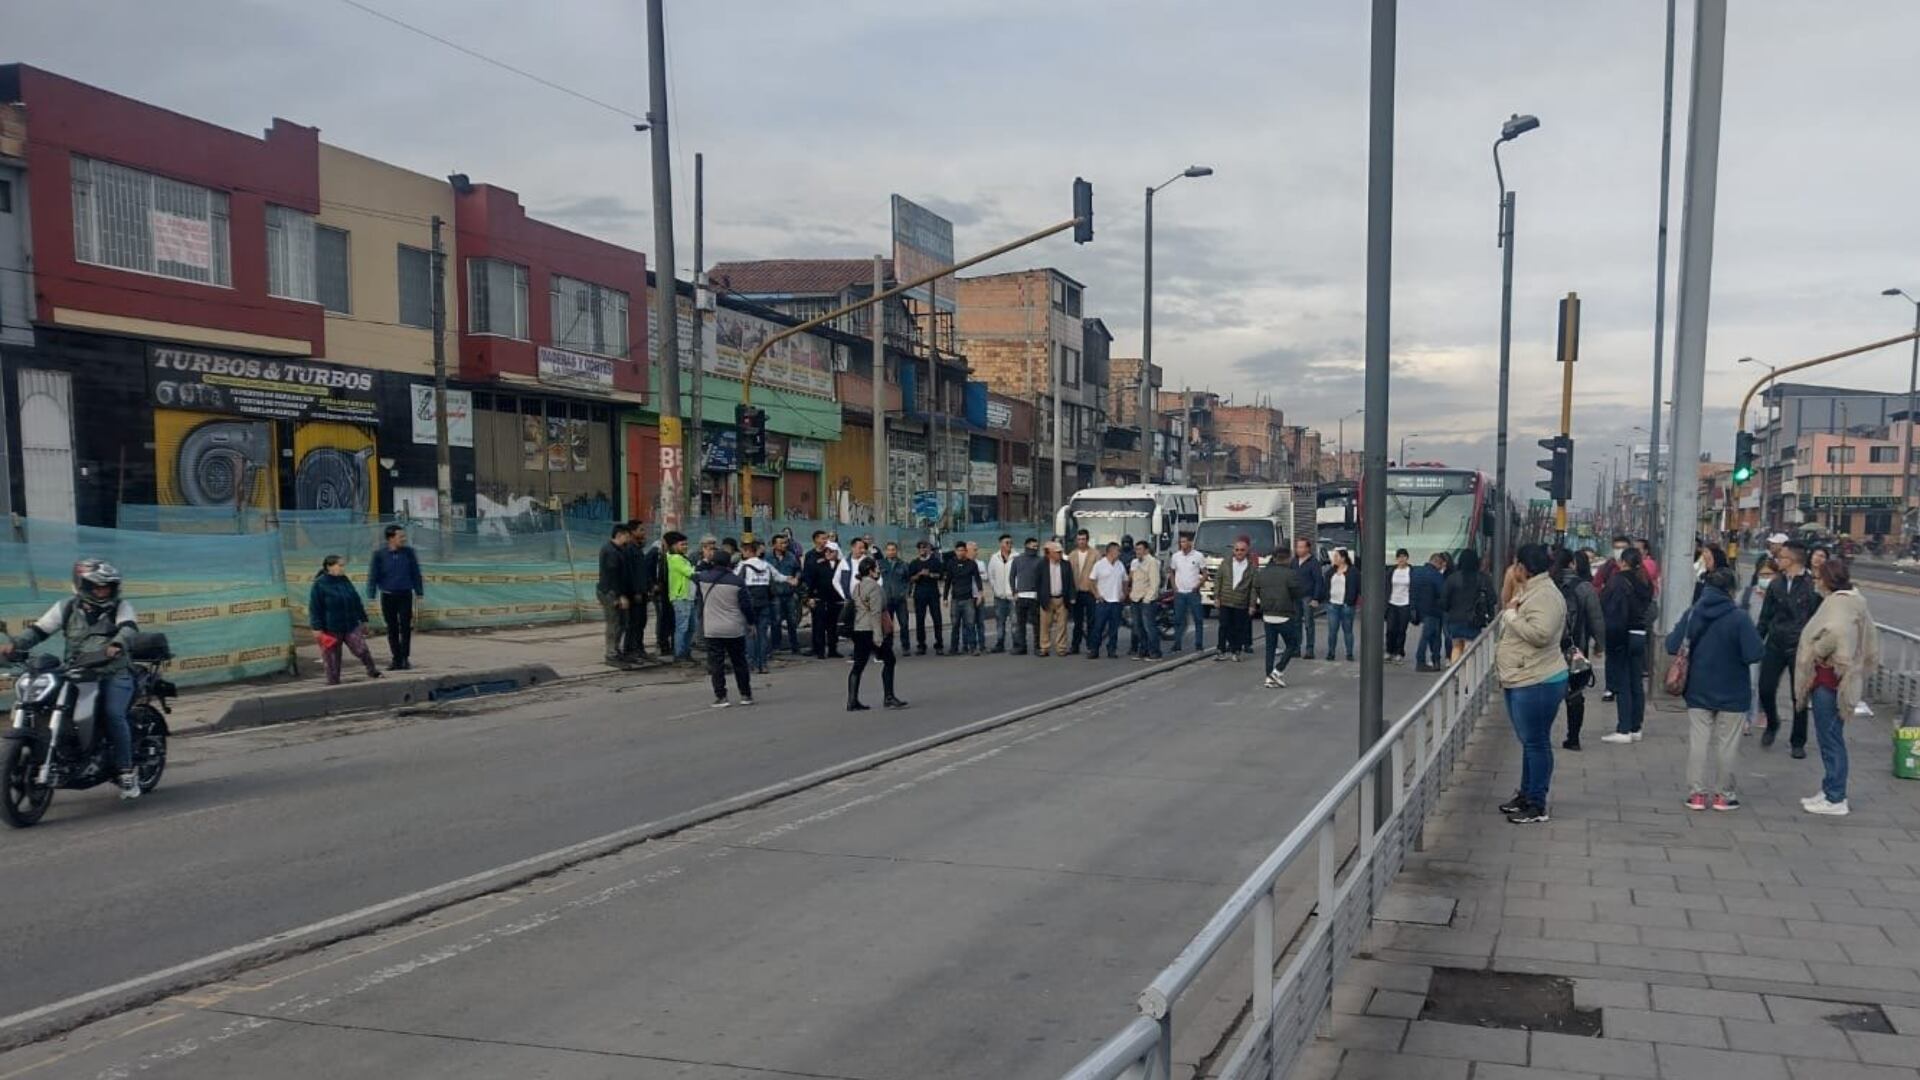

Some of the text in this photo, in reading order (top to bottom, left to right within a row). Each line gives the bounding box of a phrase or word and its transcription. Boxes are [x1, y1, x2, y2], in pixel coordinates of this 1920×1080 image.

[155, 349, 260, 377] TURBOS
[263, 363, 281, 380] &
[284, 364, 373, 391] TURBOS
